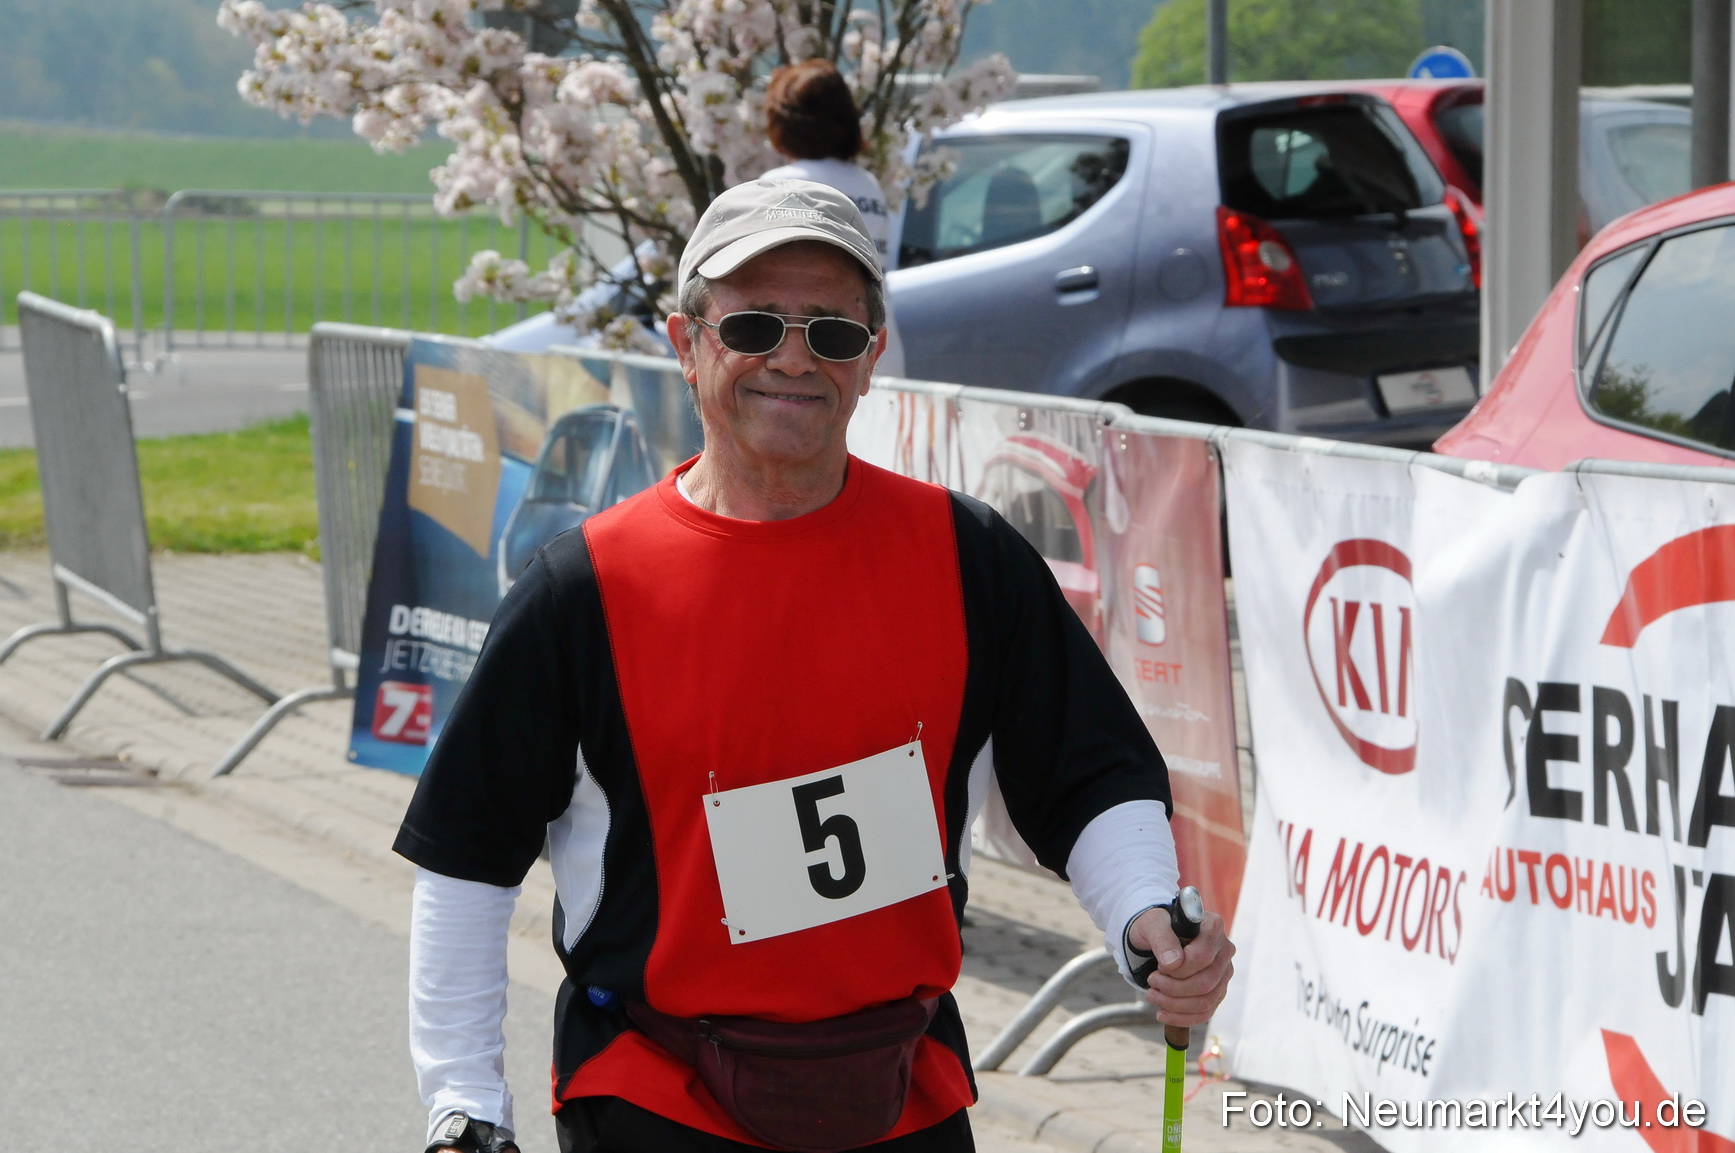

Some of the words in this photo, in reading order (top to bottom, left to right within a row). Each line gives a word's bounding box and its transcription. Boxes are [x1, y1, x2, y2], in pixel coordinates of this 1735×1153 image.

[791, 774, 866, 900] 5
[1480, 846, 1657, 929] AUTOHAUS
[1277, 819, 1314, 914] IA
[1316, 837, 1467, 966] MOTORS
[1353, 1000, 1436, 1077] Surprise
